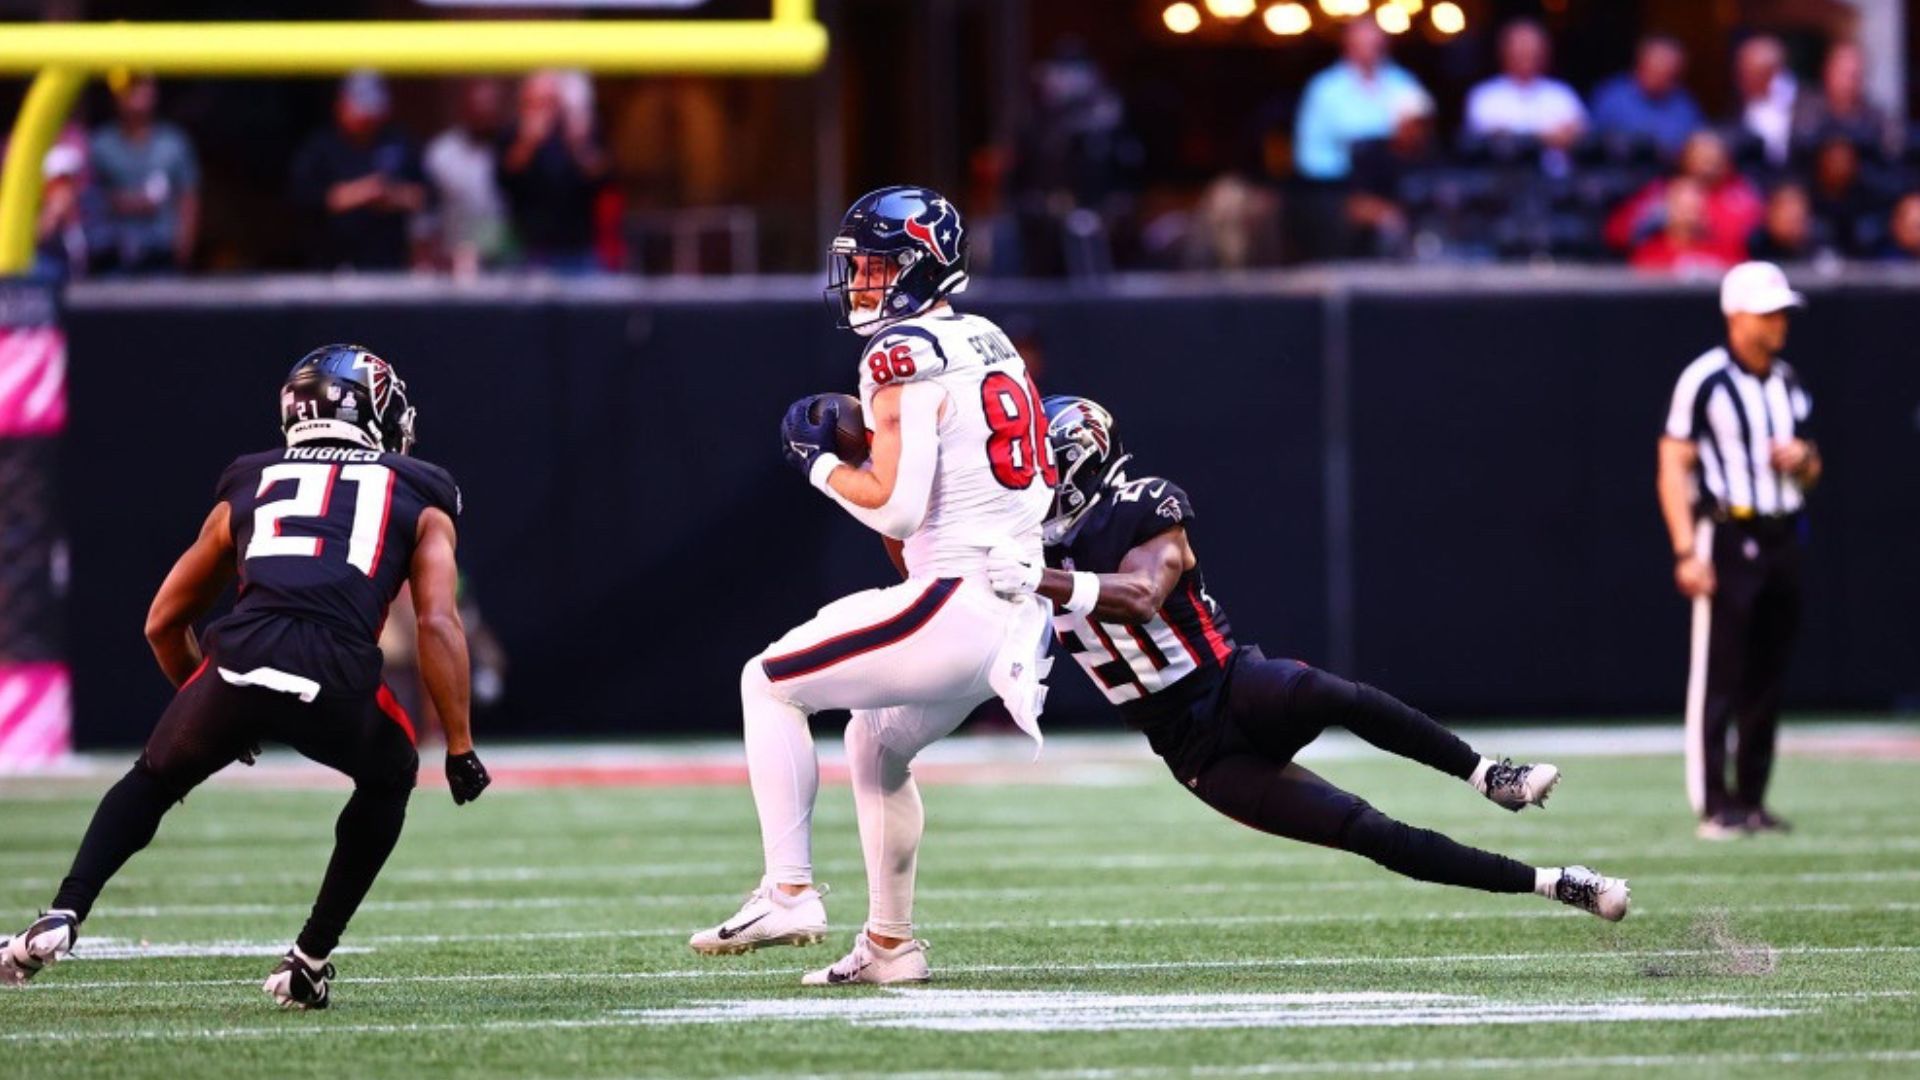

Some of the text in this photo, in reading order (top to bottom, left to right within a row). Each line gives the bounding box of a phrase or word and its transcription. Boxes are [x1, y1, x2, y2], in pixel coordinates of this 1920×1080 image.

[868, 345, 916, 385] 86
[296, 399, 318, 421] 21
[980, 371, 1058, 491] 86
[245, 462, 397, 579] 21
